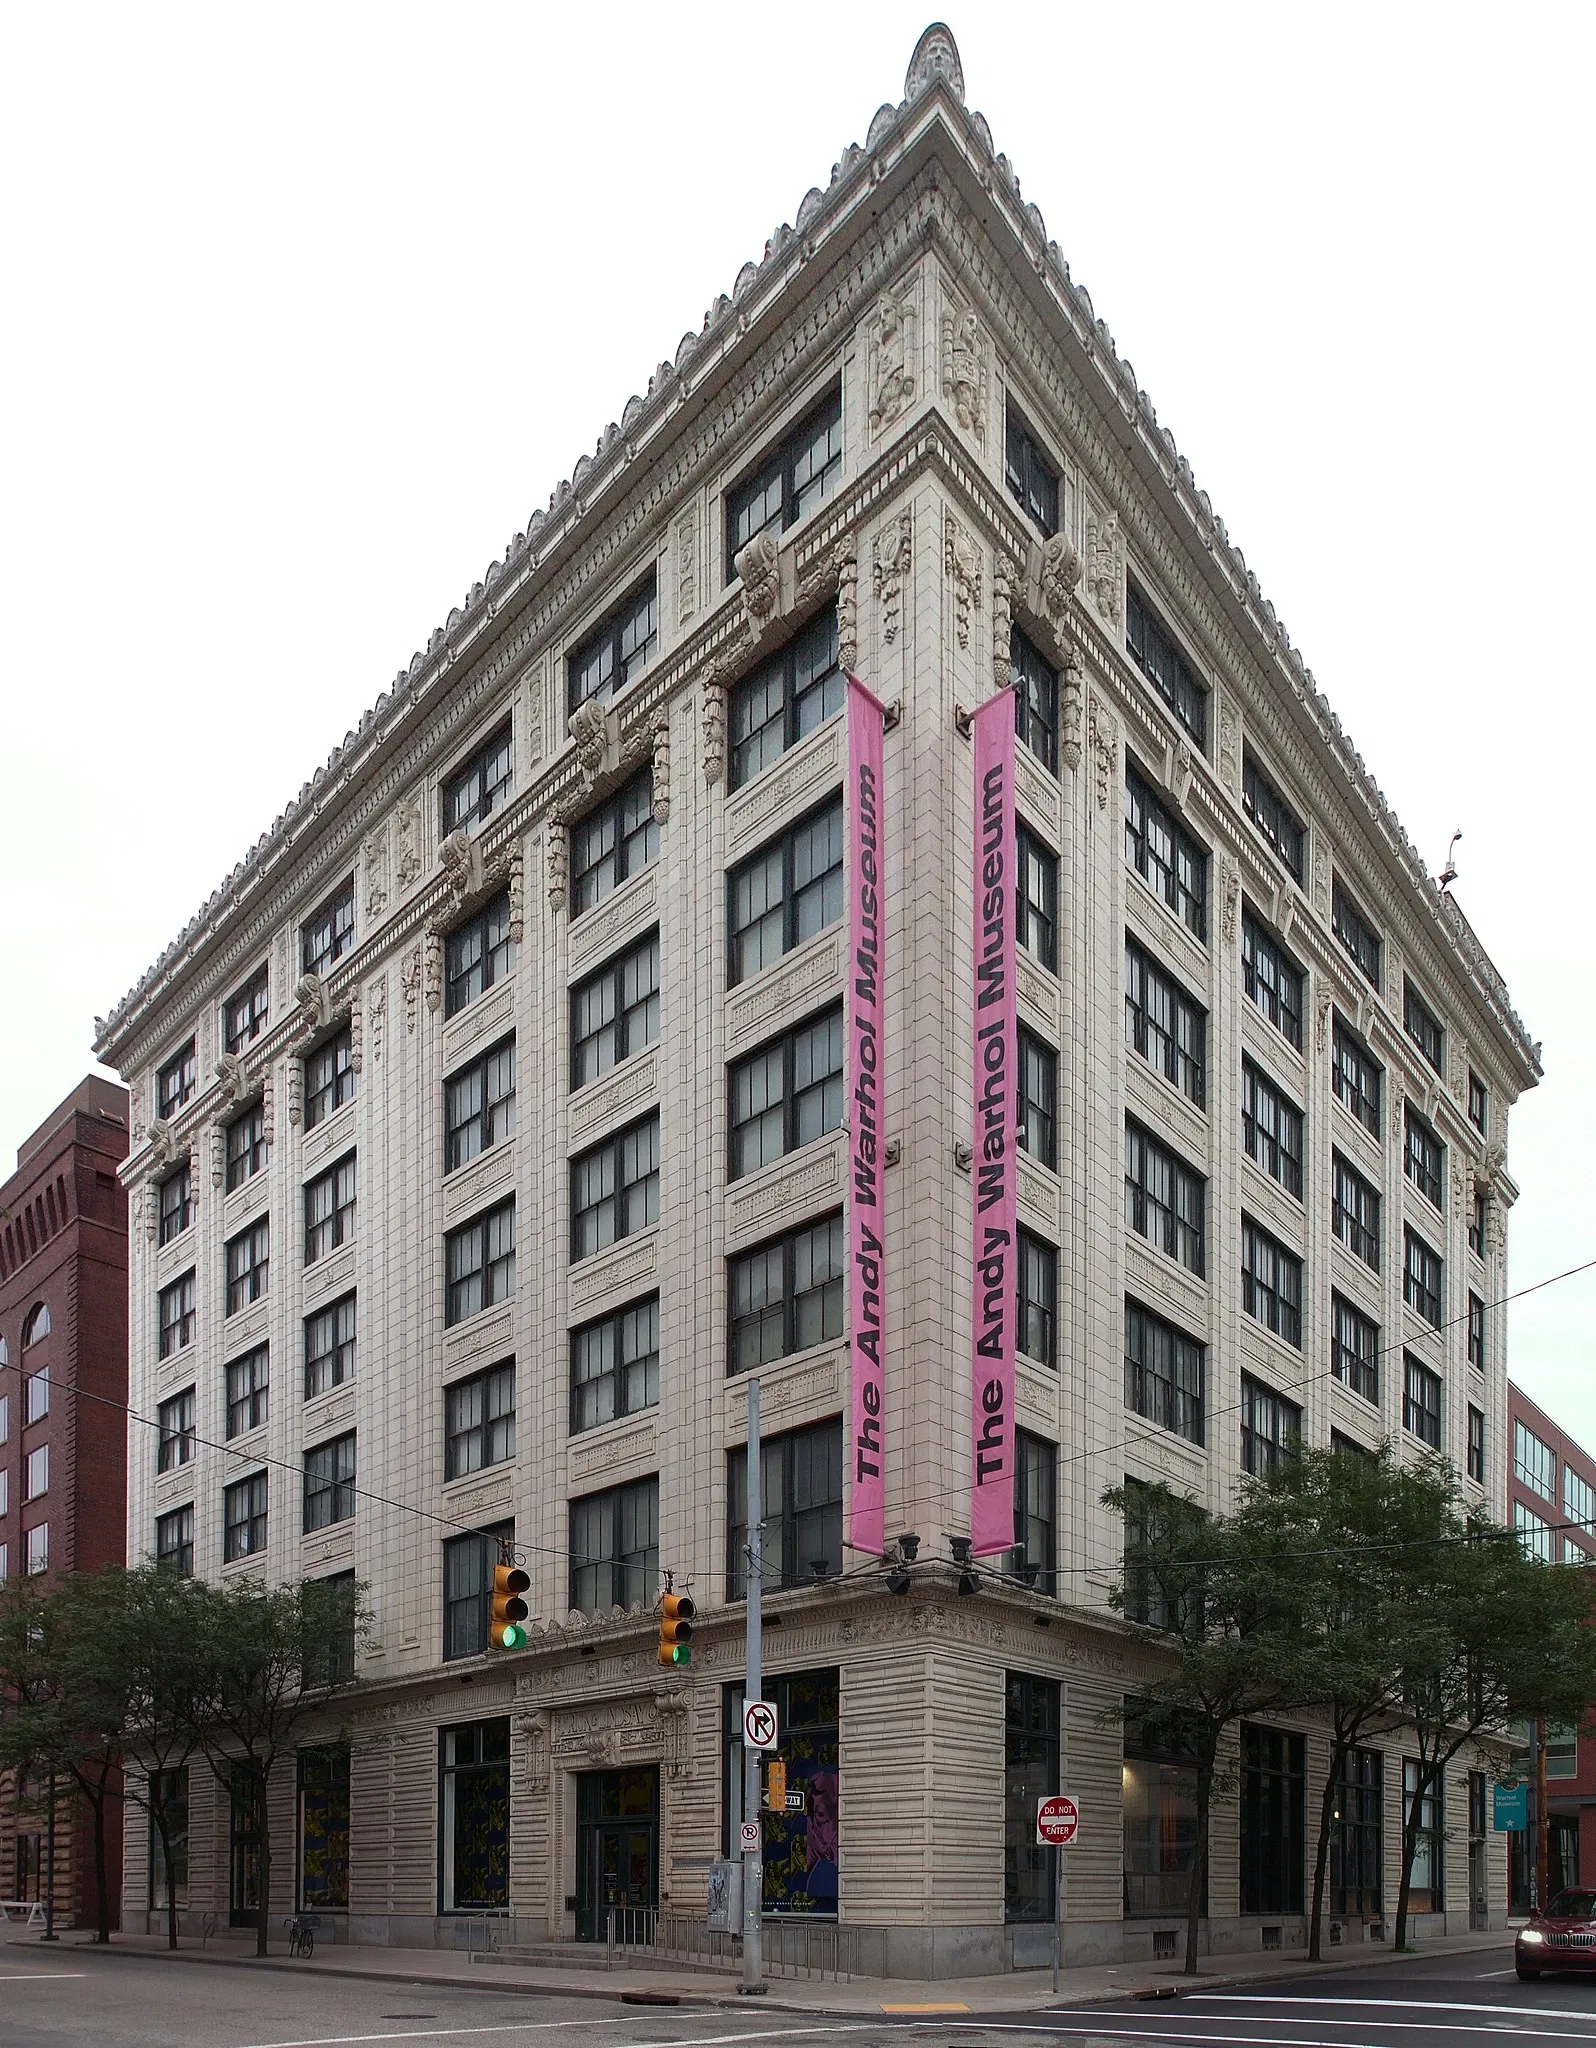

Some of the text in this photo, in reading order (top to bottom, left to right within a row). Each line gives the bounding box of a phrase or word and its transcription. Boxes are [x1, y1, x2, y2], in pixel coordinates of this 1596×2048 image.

[855, 764, 883, 1484] The Andy Warhol Museum
[976, 763, 1011, 1486] The Andy Warhol Museum
[598, 1704, 645, 1729] LINDSAY
[786, 1797, 799, 1805] WAY
[1044, 1805, 1073, 1815] DO NOT
[1046, 1826, 1069, 1835] ENTER
